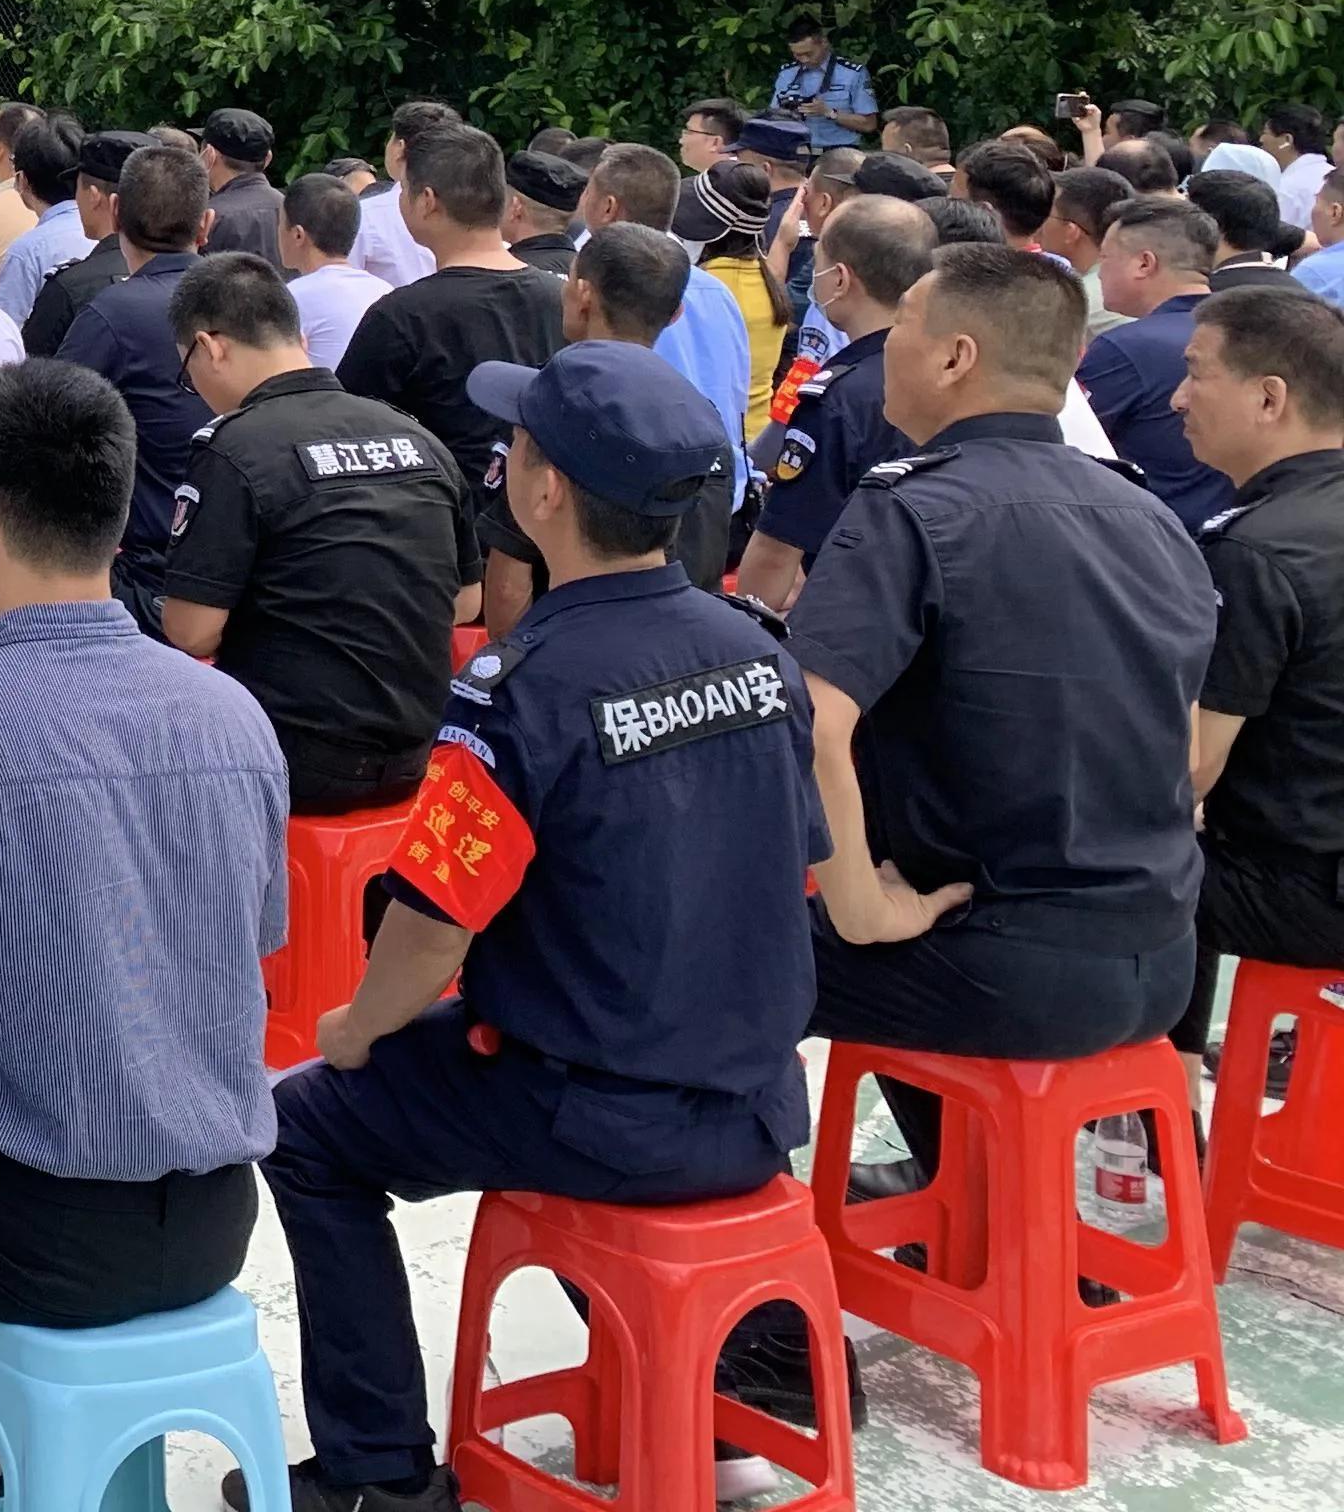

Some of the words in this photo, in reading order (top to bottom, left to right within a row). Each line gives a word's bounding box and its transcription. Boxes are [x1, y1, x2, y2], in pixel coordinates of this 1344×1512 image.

[306, 438, 424, 475] 慧江安保
[603, 662, 788, 756] 保BAOAN安
[443, 727, 489, 758] BAOAN
